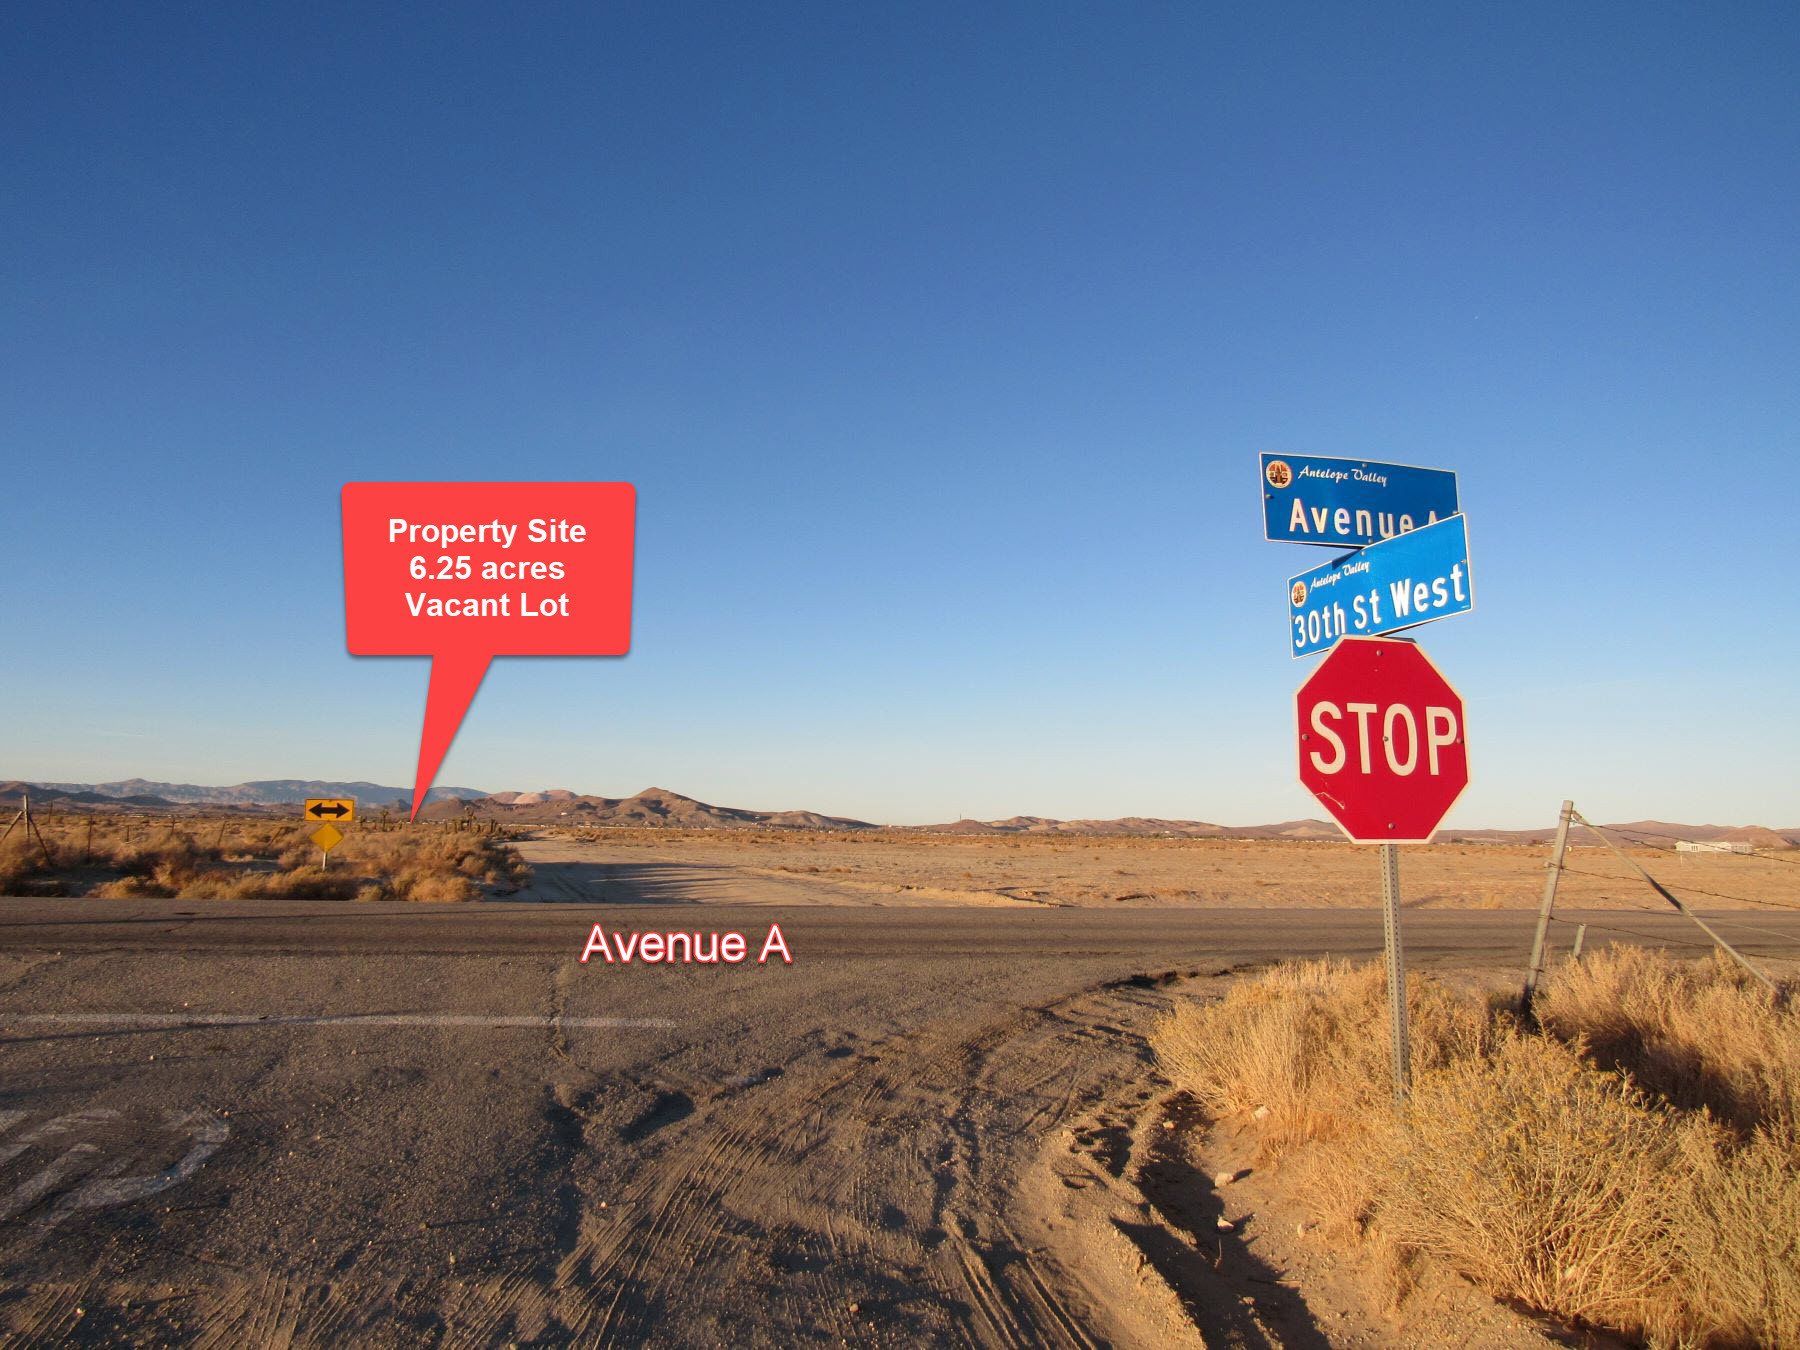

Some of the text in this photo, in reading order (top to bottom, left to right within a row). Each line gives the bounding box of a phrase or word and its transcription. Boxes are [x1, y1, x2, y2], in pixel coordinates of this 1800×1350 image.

[1298, 465, 1388, 488] Antelope Valley
[1288, 498, 1414, 538] Avenue
[1309, 561, 1370, 594] Antelope Valley
[1294, 563, 1466, 648] 30th St West
[1309, 700, 1458, 777] STOP
